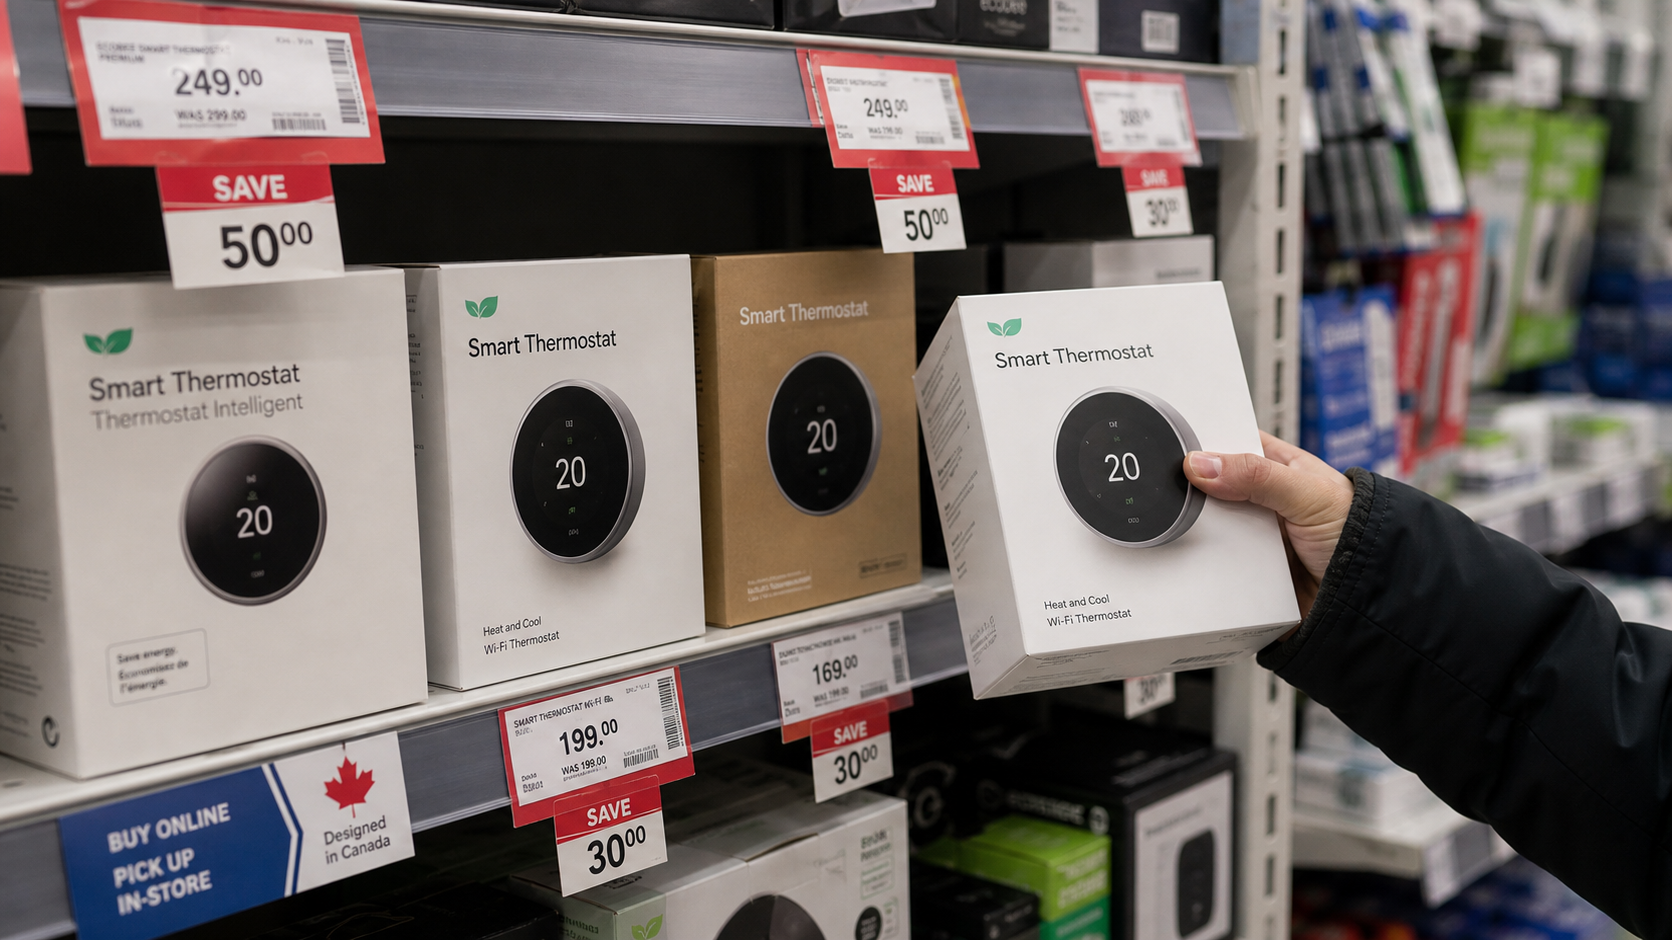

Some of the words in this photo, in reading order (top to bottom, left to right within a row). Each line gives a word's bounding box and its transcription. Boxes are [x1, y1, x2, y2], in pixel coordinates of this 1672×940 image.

[172, 68, 262, 97] 249.00
[175, 110, 203, 121] WAS
[864, 98, 908, 119] 249.00
[212, 174, 288, 202] SAVE
[897, 174, 934, 193] SAVE
[739, 305, 786, 326] Smart
[788, 300, 869, 322] Thermostat
[468, 337, 520, 357] Smart
[524, 330, 616, 353] Thermostat
[995, 349, 1050, 369] Smart
[1053, 343, 1154, 365] Thermostat
[89, 376, 165, 402] Smart
[171, 363, 300, 394] Thermostat
[91, 403, 208, 431] Thermostat
[214, 394, 303, 419] Intelligent
[806, 419, 837, 455] 20
[555, 456, 586, 490] 20
[1104, 452, 1140, 482] 20
[236, 505, 273, 539] 20
[1044, 599, 1066, 611] Heat
[1068, 596, 1086, 608] and
[1088, 594, 1110, 606] Cool
[483, 624, 504, 637] Heat
[505, 620, 521, 632] and
[522, 616, 541, 628] Cool
[1047, 614, 1073, 627] Wi-Fi
[1075, 608, 1132, 625] Thermostat
[484, 641, 507, 655] Wi-Fi
[509, 630, 560, 650] Thermostat
[812, 654, 858, 685] 169.00
[514, 715, 538, 728] SMART
[834, 720, 868, 745] SAVE
[559, 718, 618, 756] 199.00
[561, 763, 579, 775] WAS
[587, 798, 631, 827] SAVE
[107, 824, 151, 853] BUY
[156, 802, 230, 839] ONLINE
[324, 815, 387, 846] Designed
[325, 850, 338, 865] in
[341, 834, 391, 860] Canada
[113, 858, 164, 889] PICK
[168, 848, 195, 872] UP
[117, 870, 212, 916] IN-STORE
